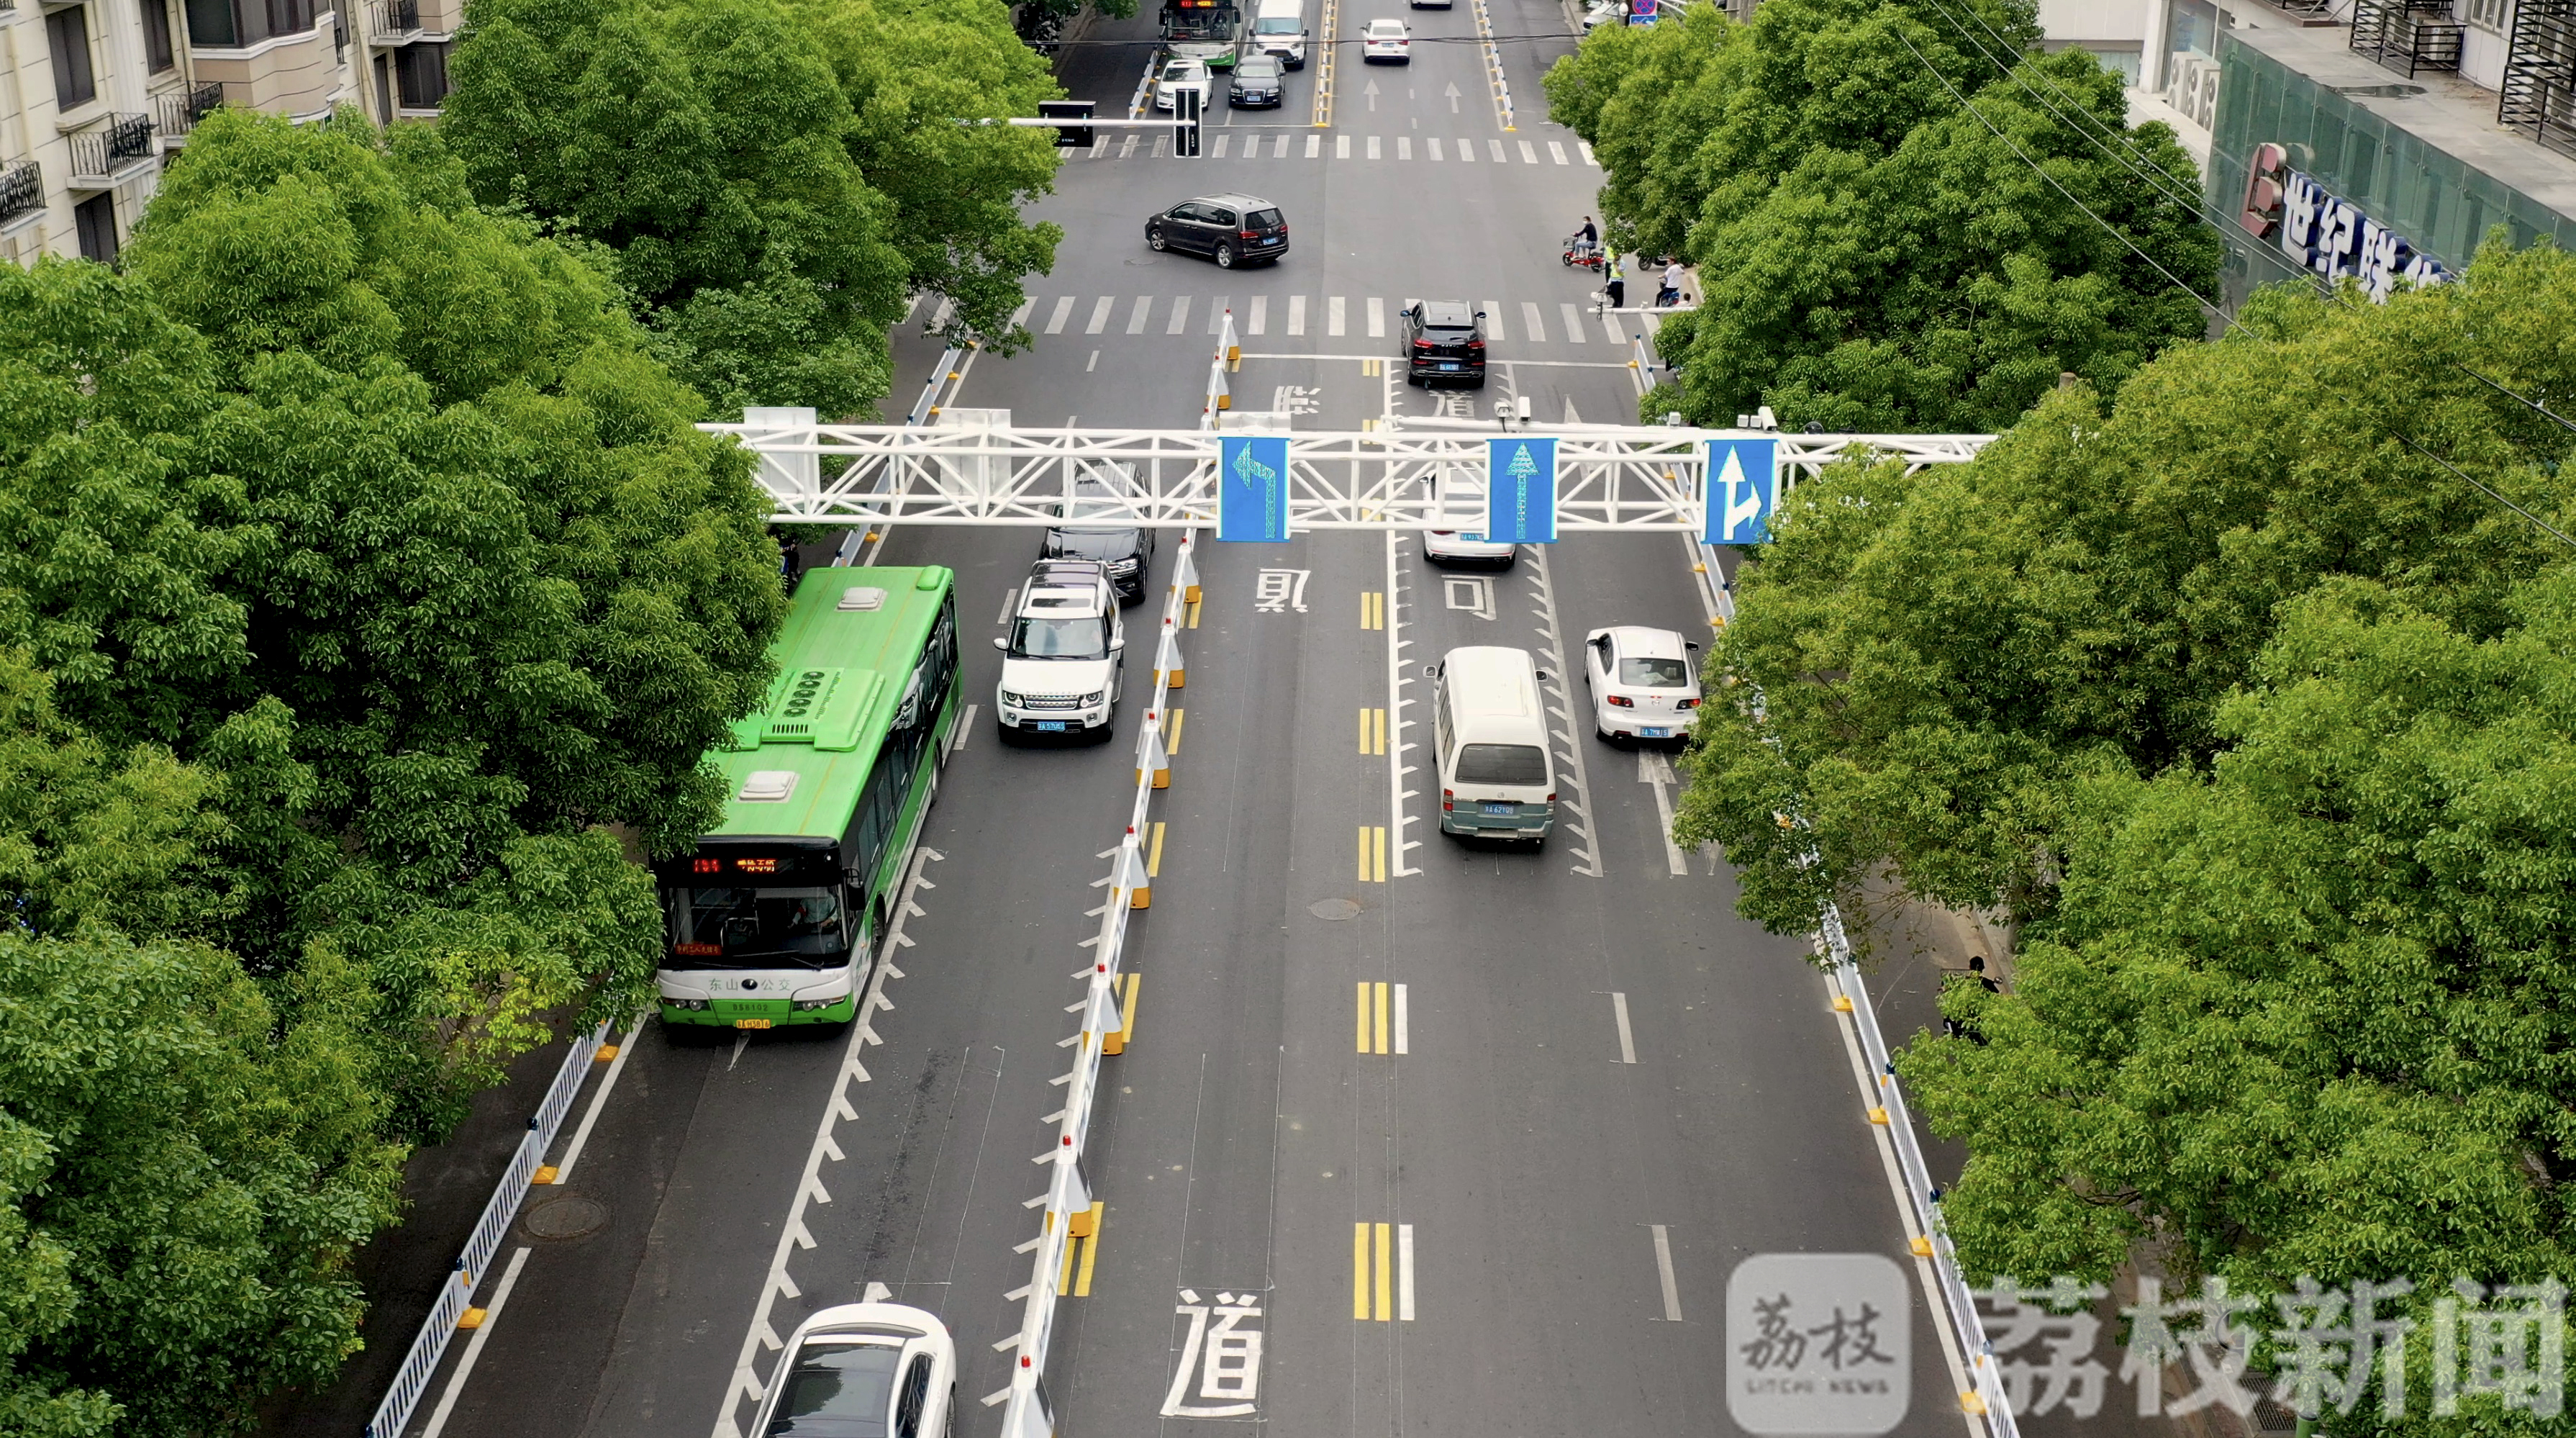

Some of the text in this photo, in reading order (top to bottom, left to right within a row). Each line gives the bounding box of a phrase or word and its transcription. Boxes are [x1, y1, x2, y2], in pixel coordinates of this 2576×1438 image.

[1255, 569, 1311, 613] 道
[1441, 574, 1497, 620] 可
[1160, 1289, 1263, 1417] 道
